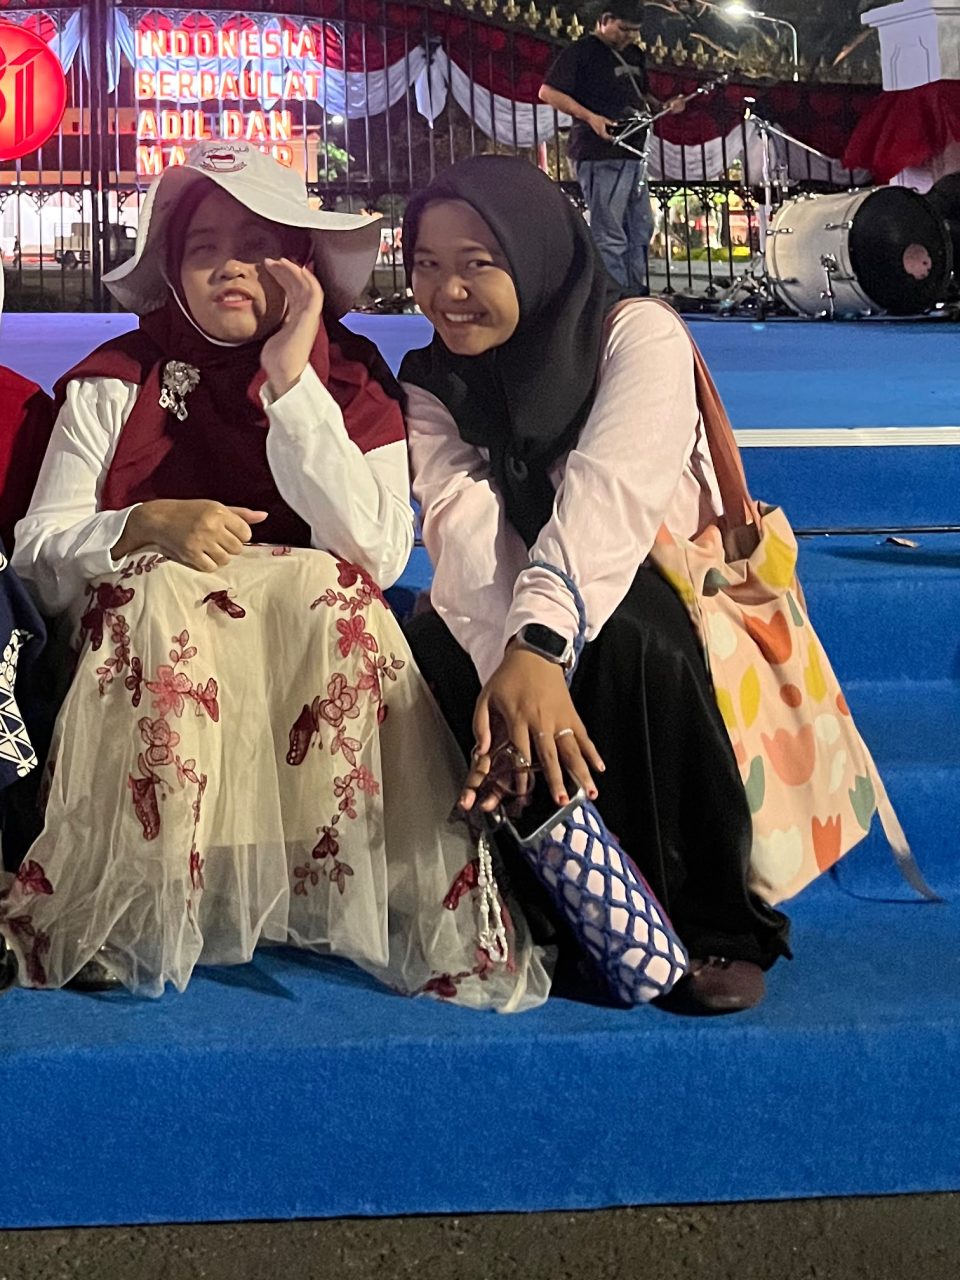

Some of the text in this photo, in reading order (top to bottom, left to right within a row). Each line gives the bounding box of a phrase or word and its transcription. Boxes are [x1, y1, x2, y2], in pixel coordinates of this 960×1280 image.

[134, 28, 319, 60] INDONESIA
[135, 69, 323, 100] BERDAULAT
[137, 109, 292, 141] ADIL DAN
